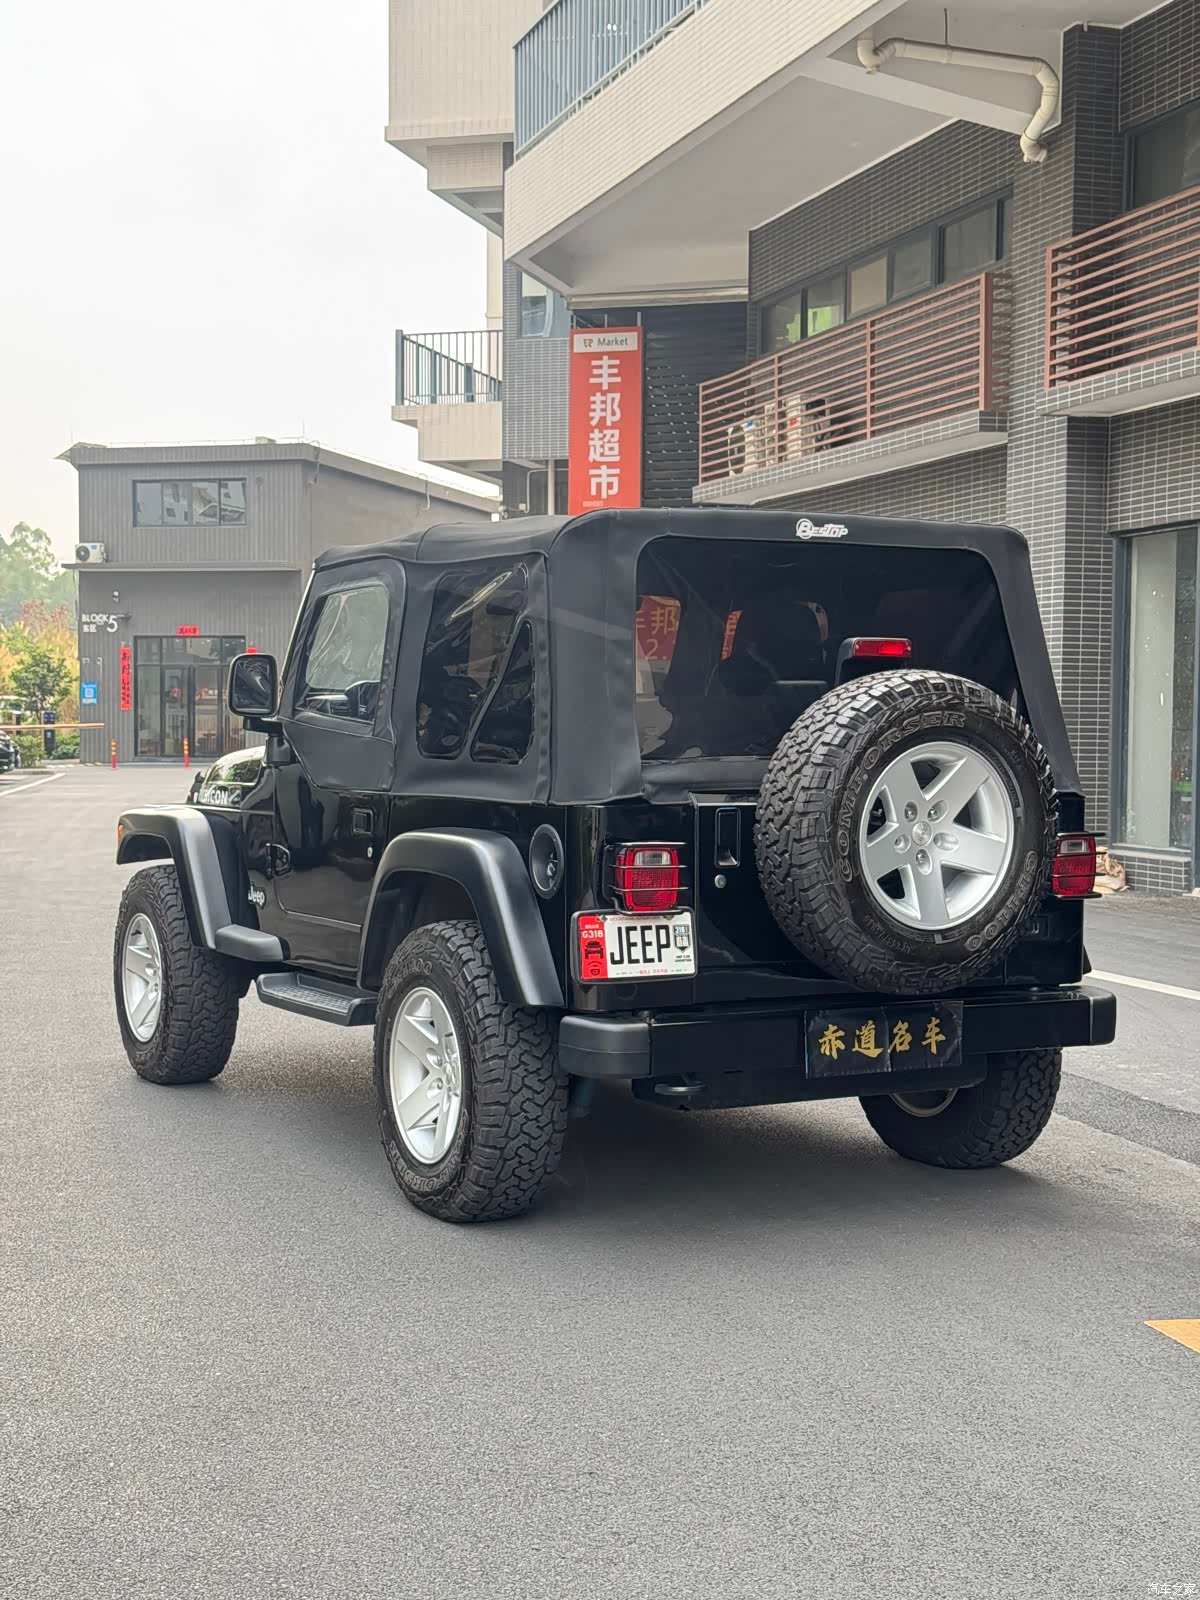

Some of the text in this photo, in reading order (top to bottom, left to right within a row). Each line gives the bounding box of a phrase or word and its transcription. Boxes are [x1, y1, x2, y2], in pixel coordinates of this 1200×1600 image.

[597, 337, 629, 346] Market
[588, 355, 622, 499] 丰邦超市
[81, 613, 118, 633] BLOCK 5
[247, 883, 266, 906] Jeep
[582, 930, 604, 939] G318
[610, 925, 671, 965] JEEP
[818, 1016, 947, 1060] 赤道名车
